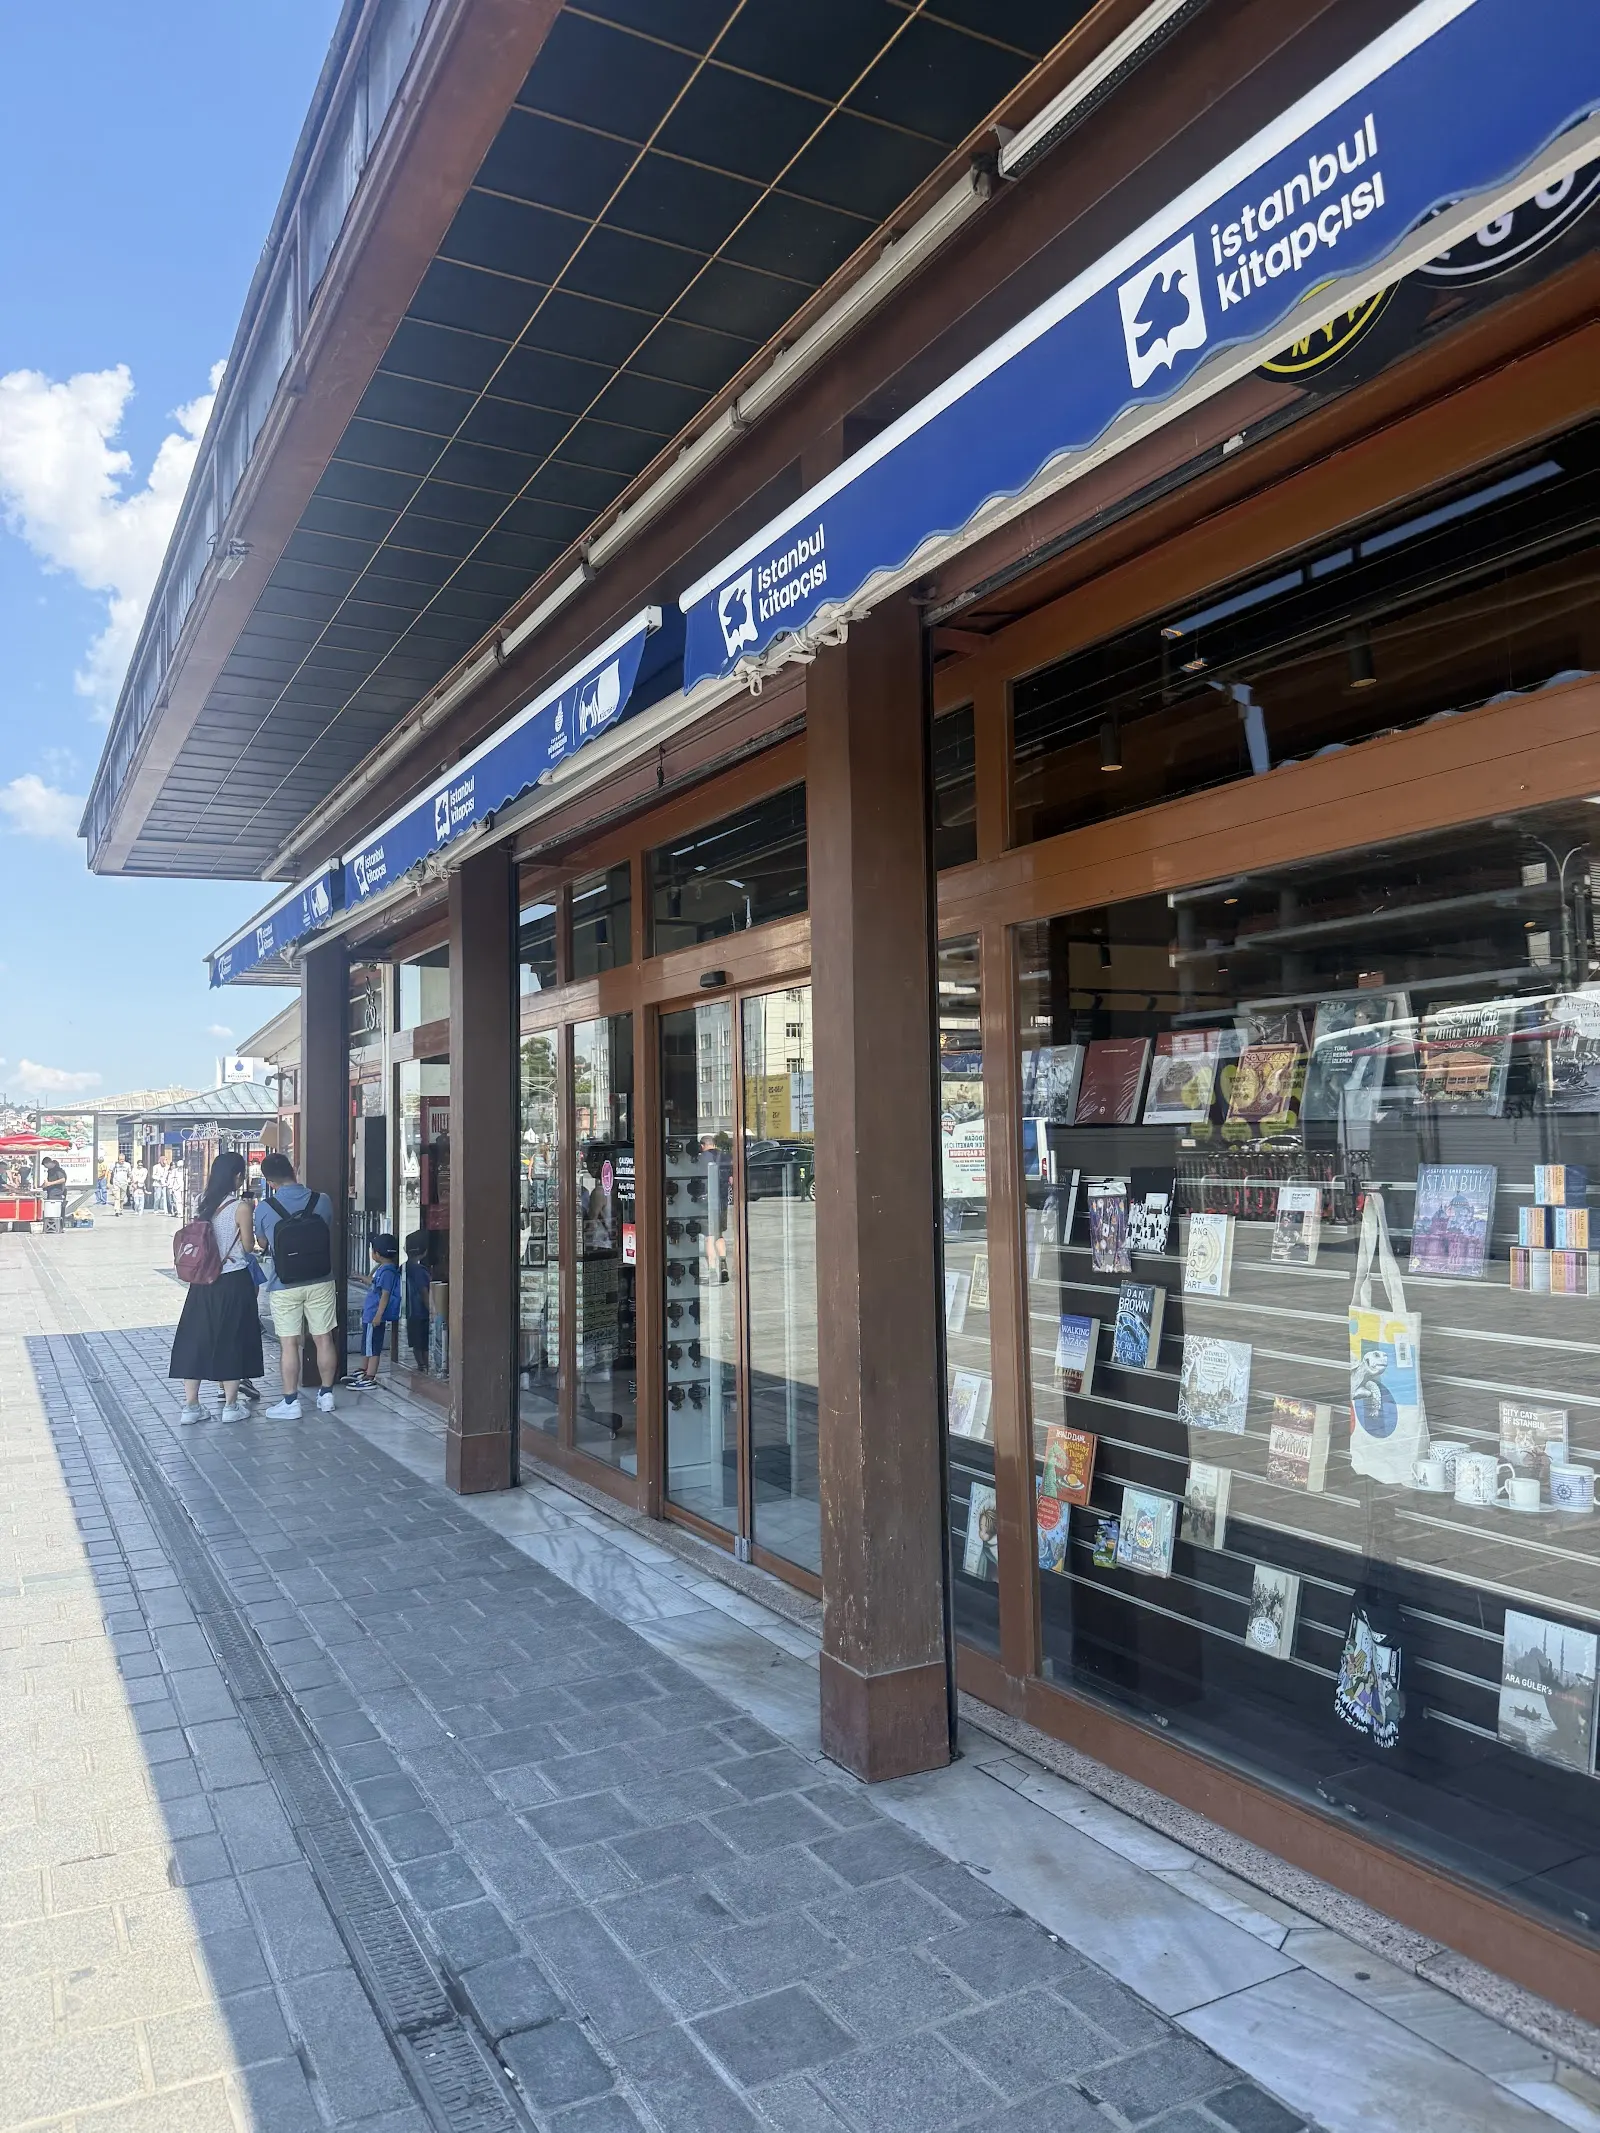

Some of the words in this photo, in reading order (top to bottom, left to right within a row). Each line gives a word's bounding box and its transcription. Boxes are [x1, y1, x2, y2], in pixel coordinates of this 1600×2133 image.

[1210, 112, 1378, 267] istanbul
[1216, 171, 1386, 312] kitapçısı
[757, 522, 825, 593] istanbul
[759, 559, 828, 623] kitapçısı
[450, 774, 475, 807] istanbul
[1127, 1288, 1145, 1300] DAN
[1119, 1297, 1150, 1314] BROWN
[1061, 1325, 1090, 1337] WALKING
[1059, 1336, 1089, 1349] ANZACS
[1503, 1408, 1519, 1417] CITY
[1520, 1411, 1539, 1421] CATS
[1503, 1416, 1512, 1425] OF
[1072, 1433, 1086, 1443] DAHL
[1504, 1672, 1521, 1686] ARA
